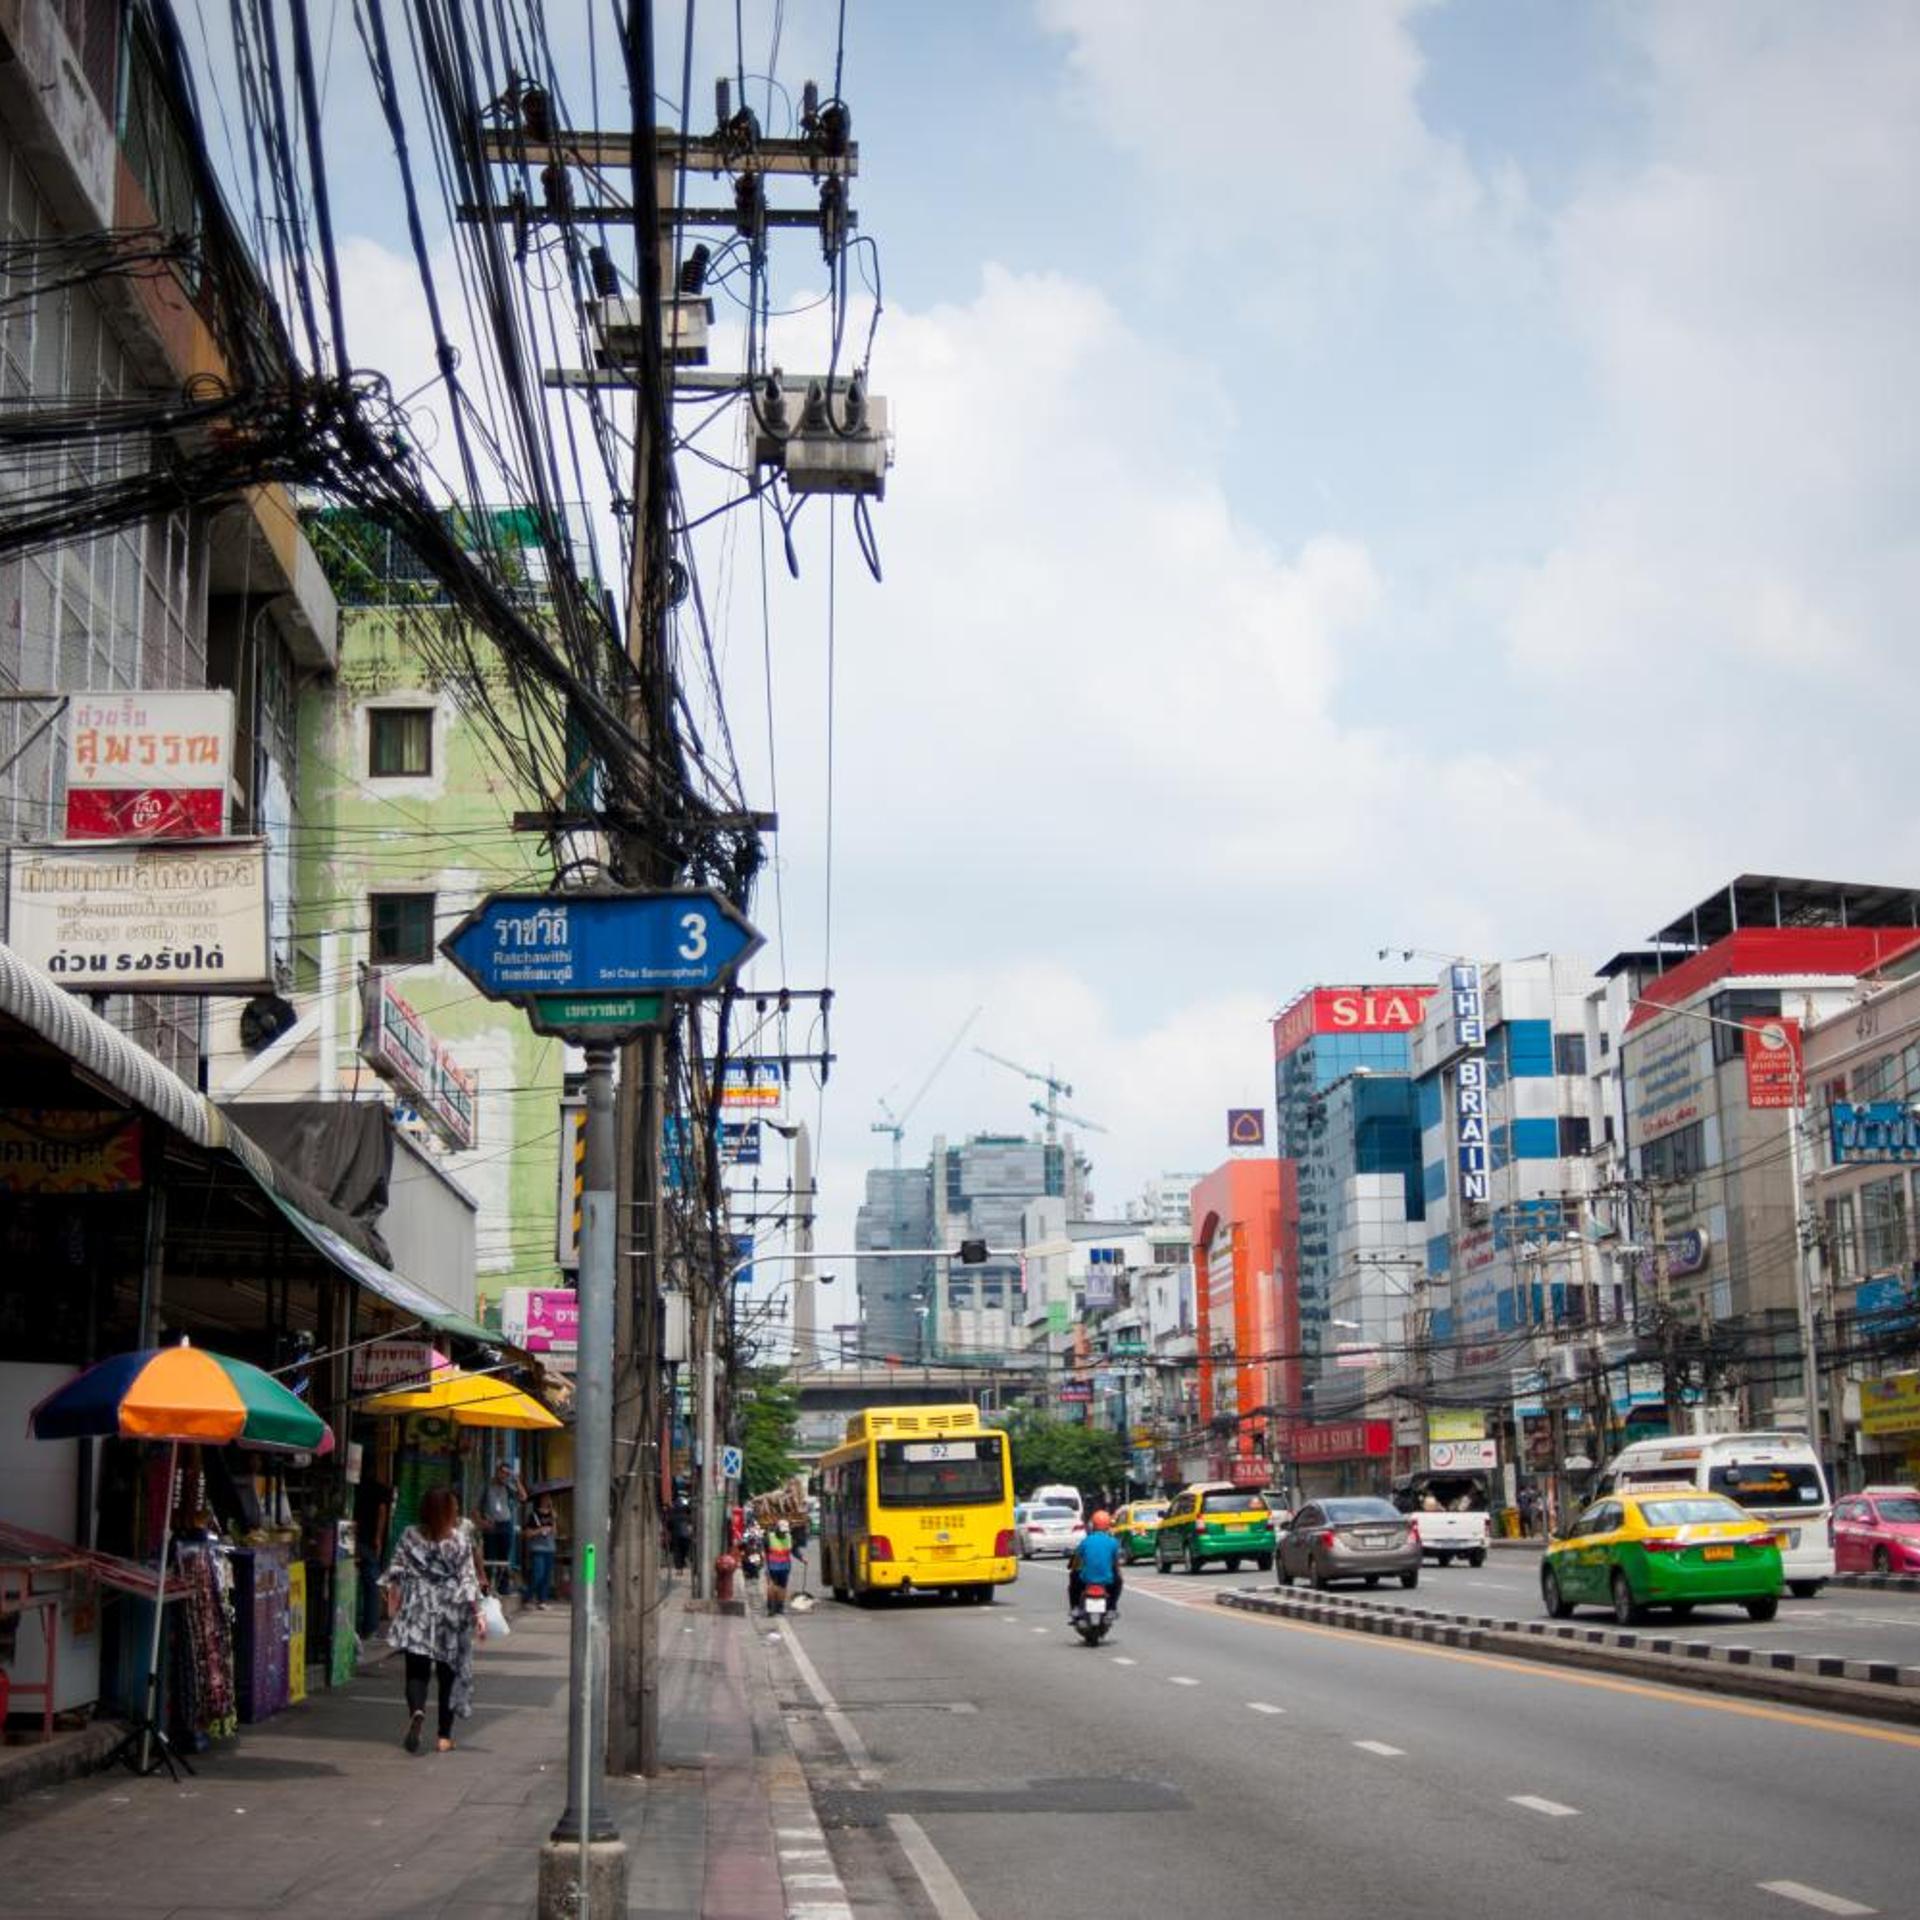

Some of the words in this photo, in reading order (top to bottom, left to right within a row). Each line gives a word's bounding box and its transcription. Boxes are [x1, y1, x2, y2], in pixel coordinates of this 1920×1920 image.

[76, 729, 219, 778] สุพรรณ
[494, 907, 568, 946] ราชวิถี
[678, 913, 708, 961] 3
[48, 948, 107, 972] ด่วน
[494, 952, 572, 964] Ratchawithi
[600, 969, 615, 978] Soi
[1456, 967, 1475, 1042] THE
[1459, 1063, 1484, 1198] BRAIN
[930, 1446, 950, 1458] 92
